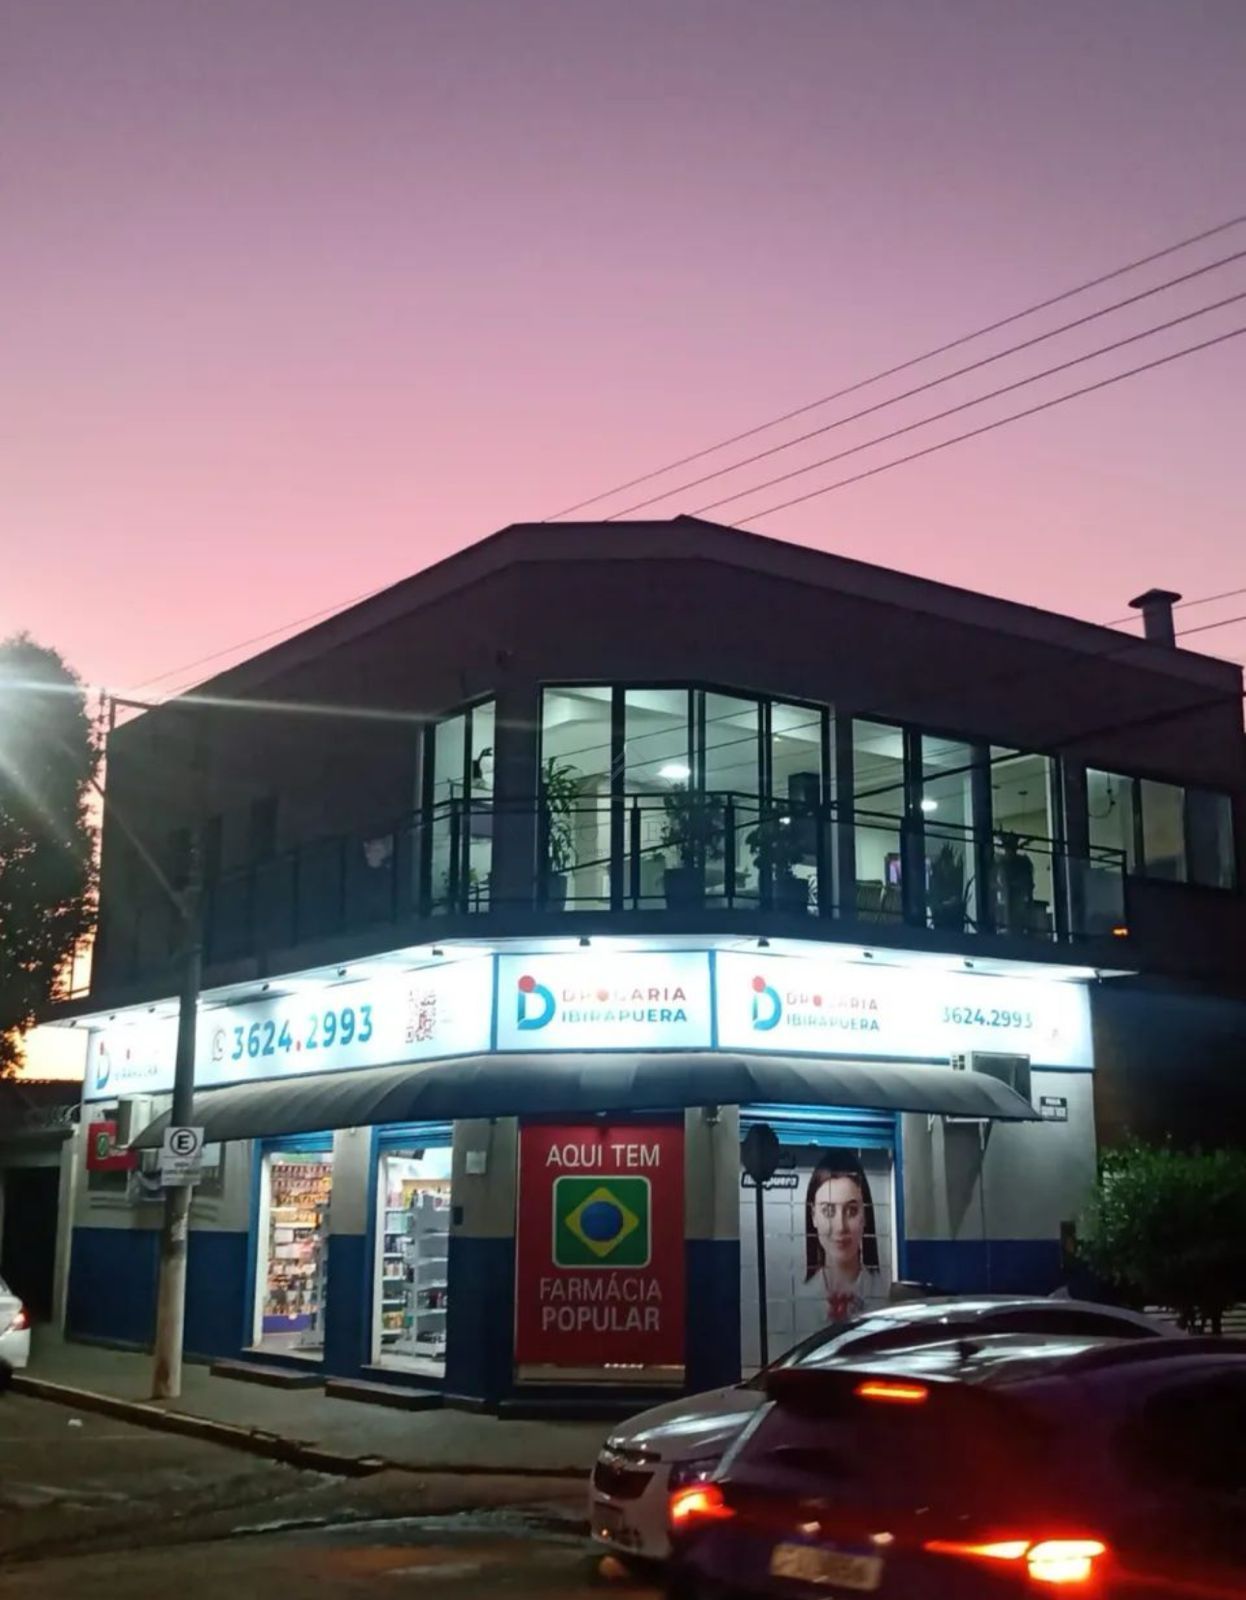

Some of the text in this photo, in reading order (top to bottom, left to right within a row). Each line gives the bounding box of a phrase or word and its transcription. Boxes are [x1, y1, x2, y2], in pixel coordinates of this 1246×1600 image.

[562, 1008, 687, 1023] IBIRAPUERA
[786, 1013, 880, 1031] IBIRAPUERA
[942, 1006, 1033, 1029] 3624.2993
[231, 1005, 373, 1061] 3624.2993
[177, 1134, 190, 1150] E
[546, 1144, 661, 1168] AQUI TEM
[539, 1272, 663, 1301] FARMÁCIA
[541, 1306, 661, 1332] POPULAR
